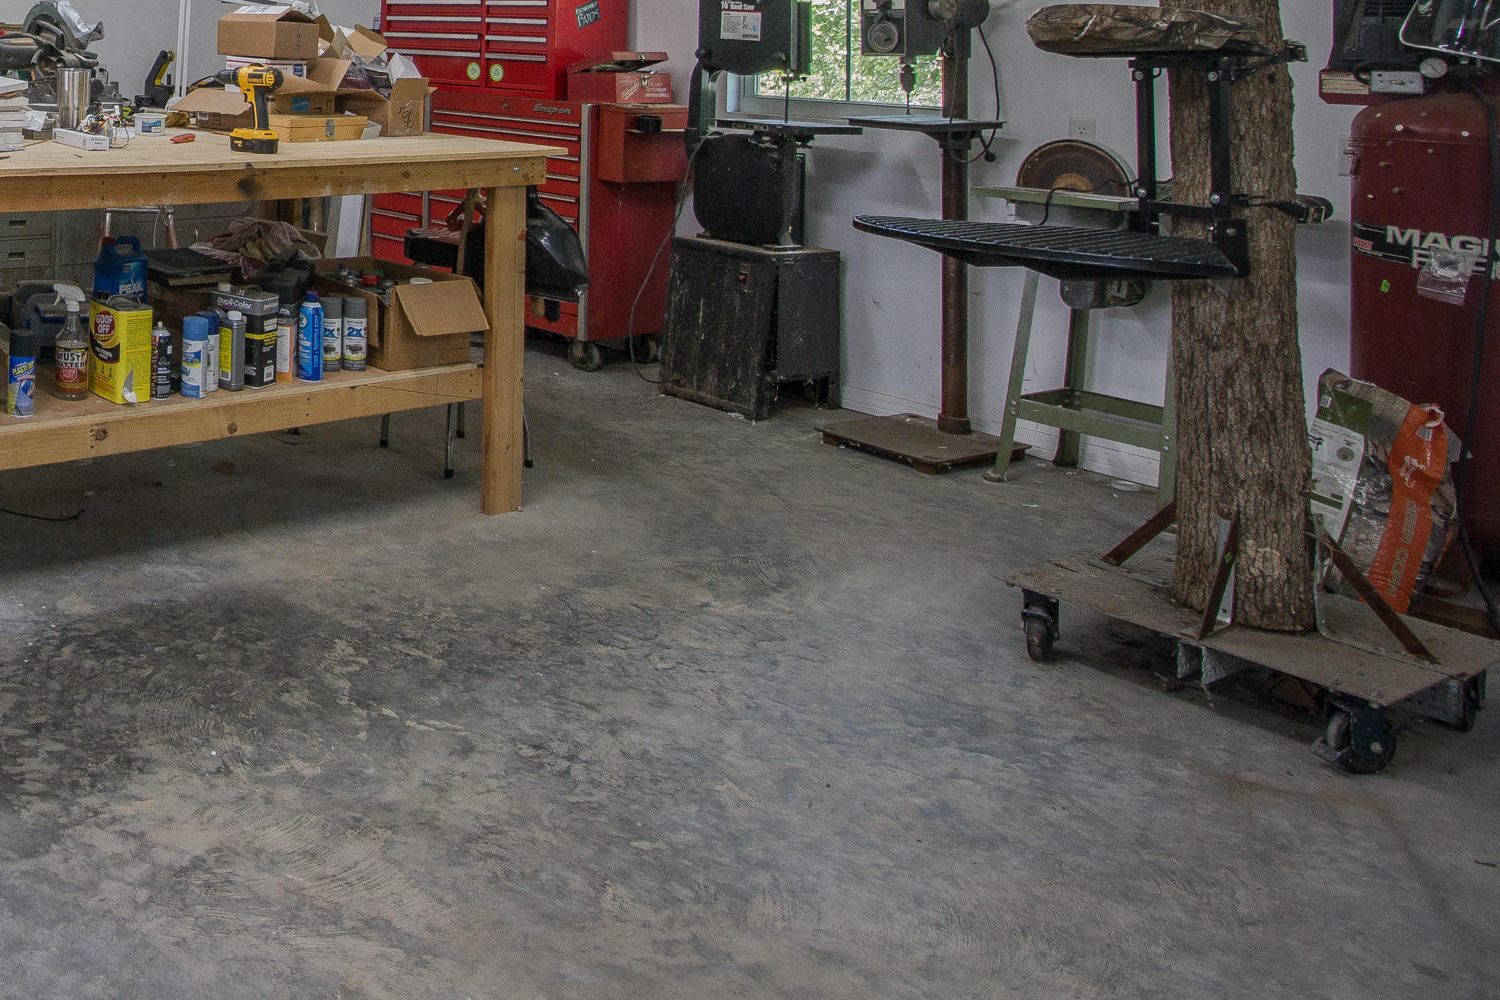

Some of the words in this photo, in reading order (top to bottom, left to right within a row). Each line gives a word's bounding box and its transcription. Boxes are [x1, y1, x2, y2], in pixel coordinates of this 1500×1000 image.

[533, 103, 572, 115] Snap-on
[118, 283, 143, 295] PEAK
[217, 297, 252, 309] Dupli-Color
[96, 314, 114, 324] GOOF
[98, 323, 111, 334] OFF
[58, 352, 81, 361] RUST
[1401, 497, 1418, 544] DEER
[1385, 548, 1409, 597] CORN
